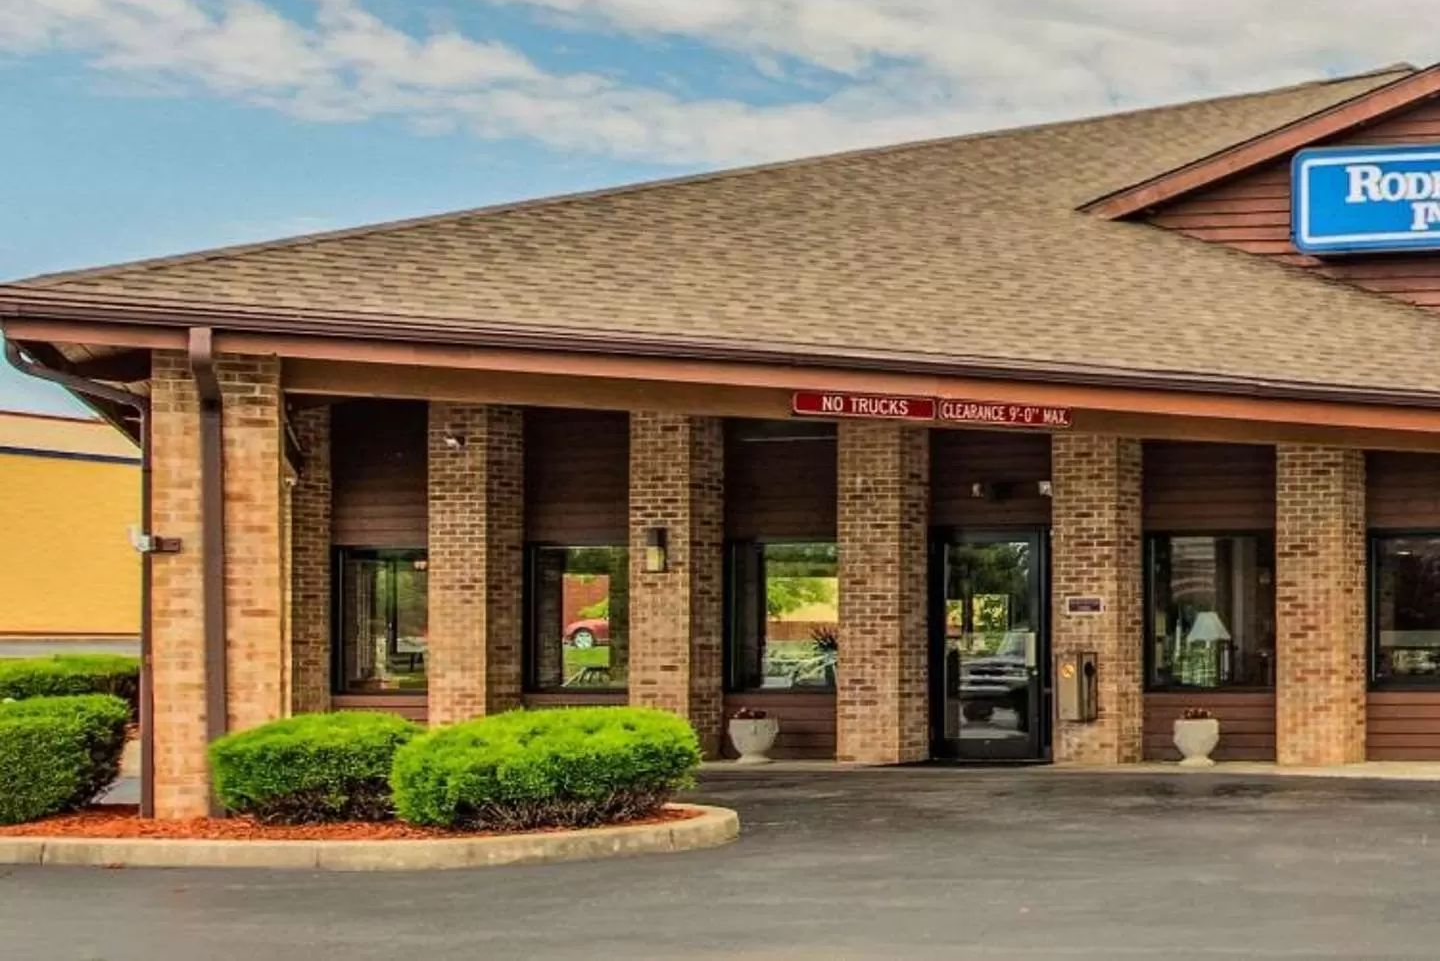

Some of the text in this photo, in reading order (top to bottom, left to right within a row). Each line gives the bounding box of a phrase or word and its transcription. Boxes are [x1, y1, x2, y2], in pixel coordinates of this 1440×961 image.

[822, 396, 908, 415] NO TRUCKS
[942, 403, 1004, 421] CLEARANCE
